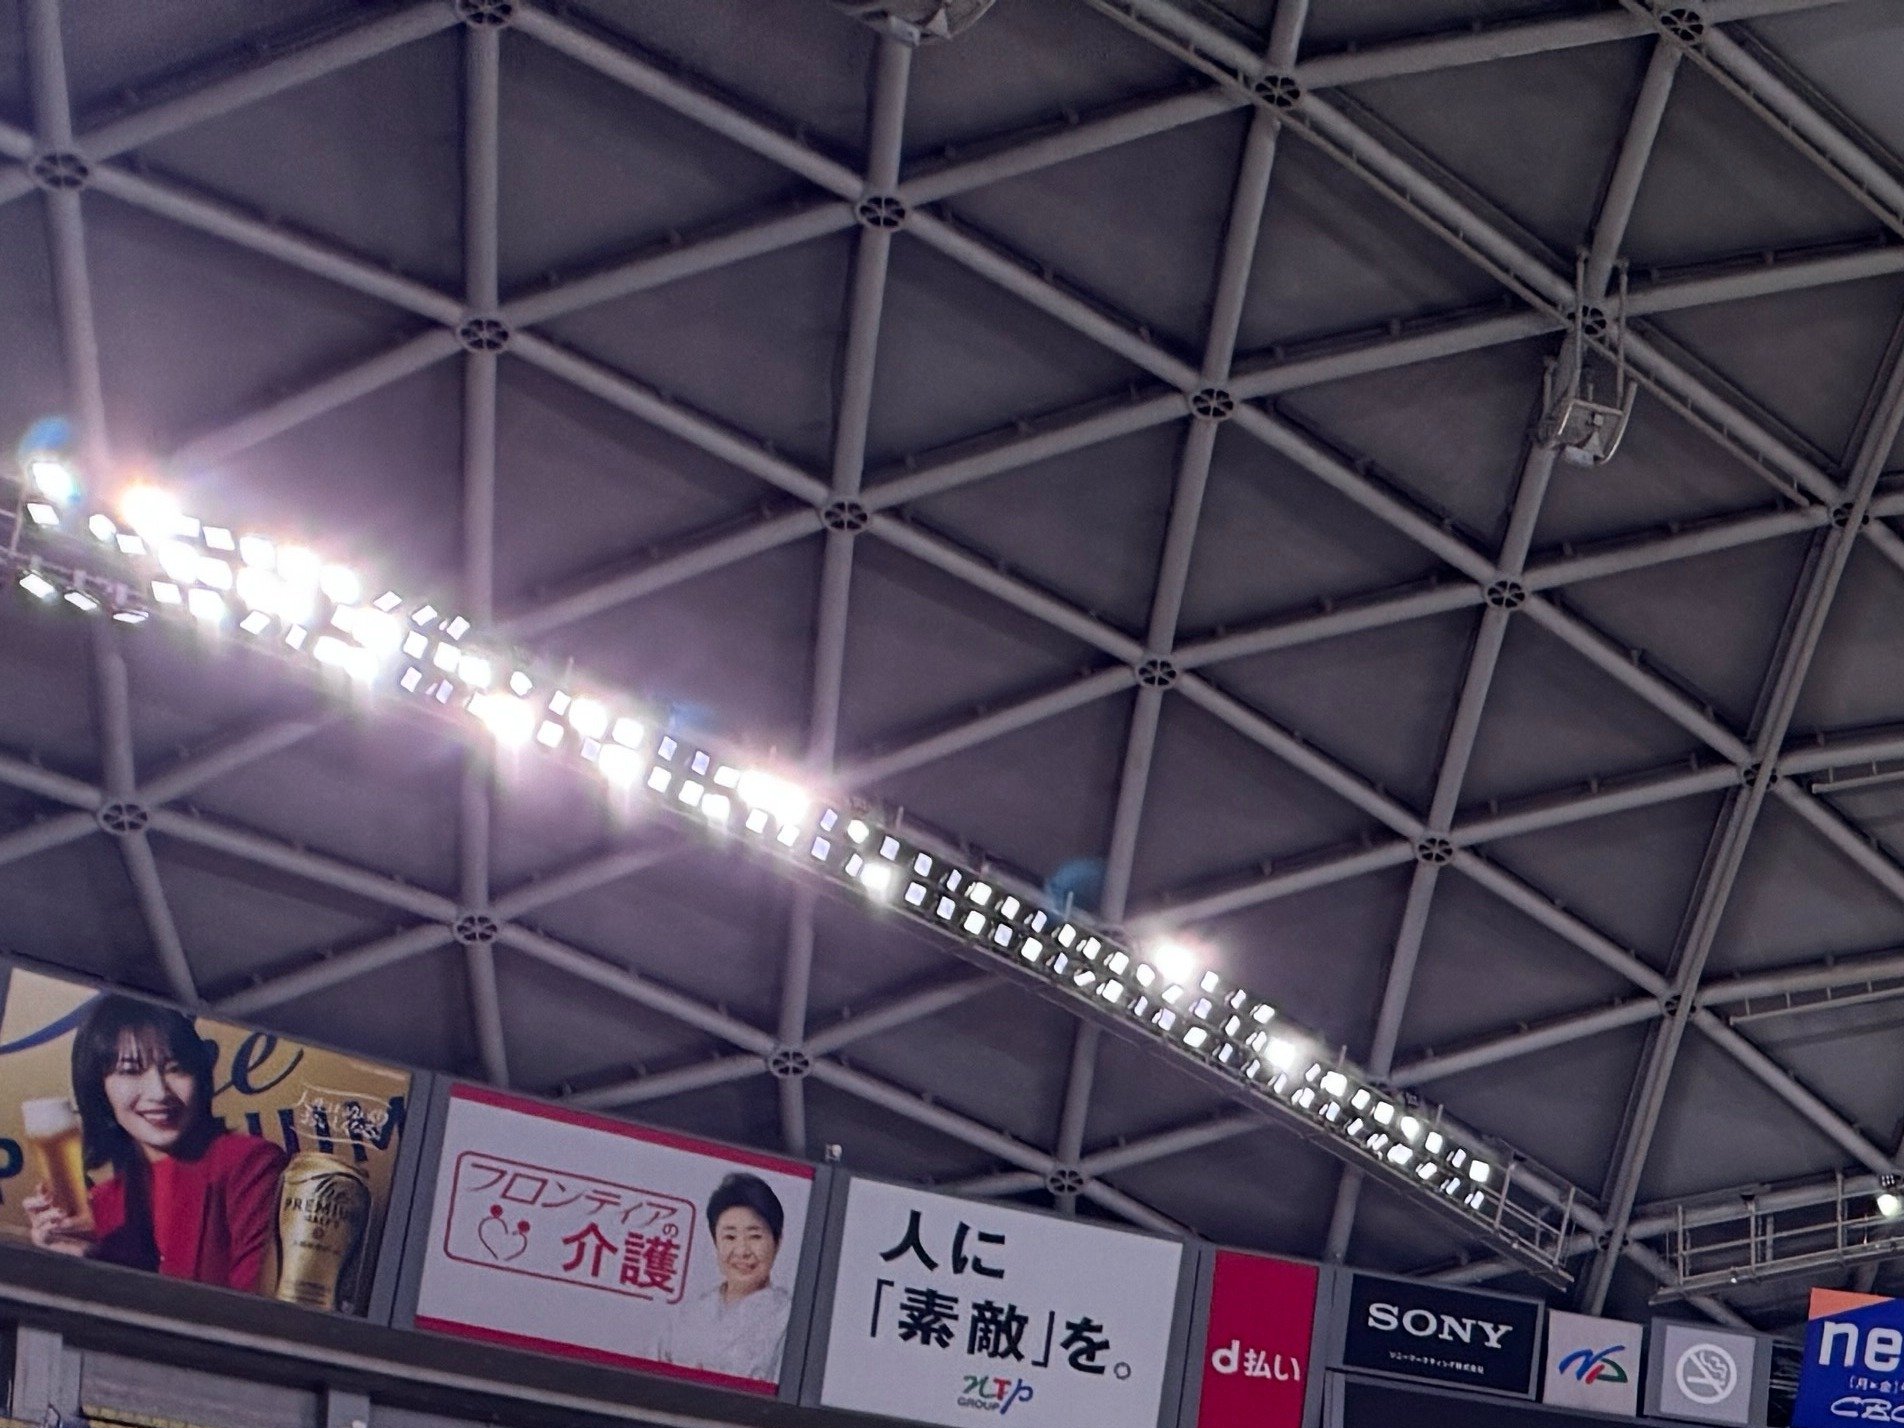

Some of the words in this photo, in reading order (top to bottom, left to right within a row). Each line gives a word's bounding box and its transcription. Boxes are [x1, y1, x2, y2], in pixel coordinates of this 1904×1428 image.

[562, 1222, 681, 1293] 介護
[880, 1208, 1007, 1280] 人に
[868, 1277, 1133, 1382] 「素敵」を。
[1211, 1339, 1301, 1381] d払い
[1367, 1302, 1514, 1349] SONY
